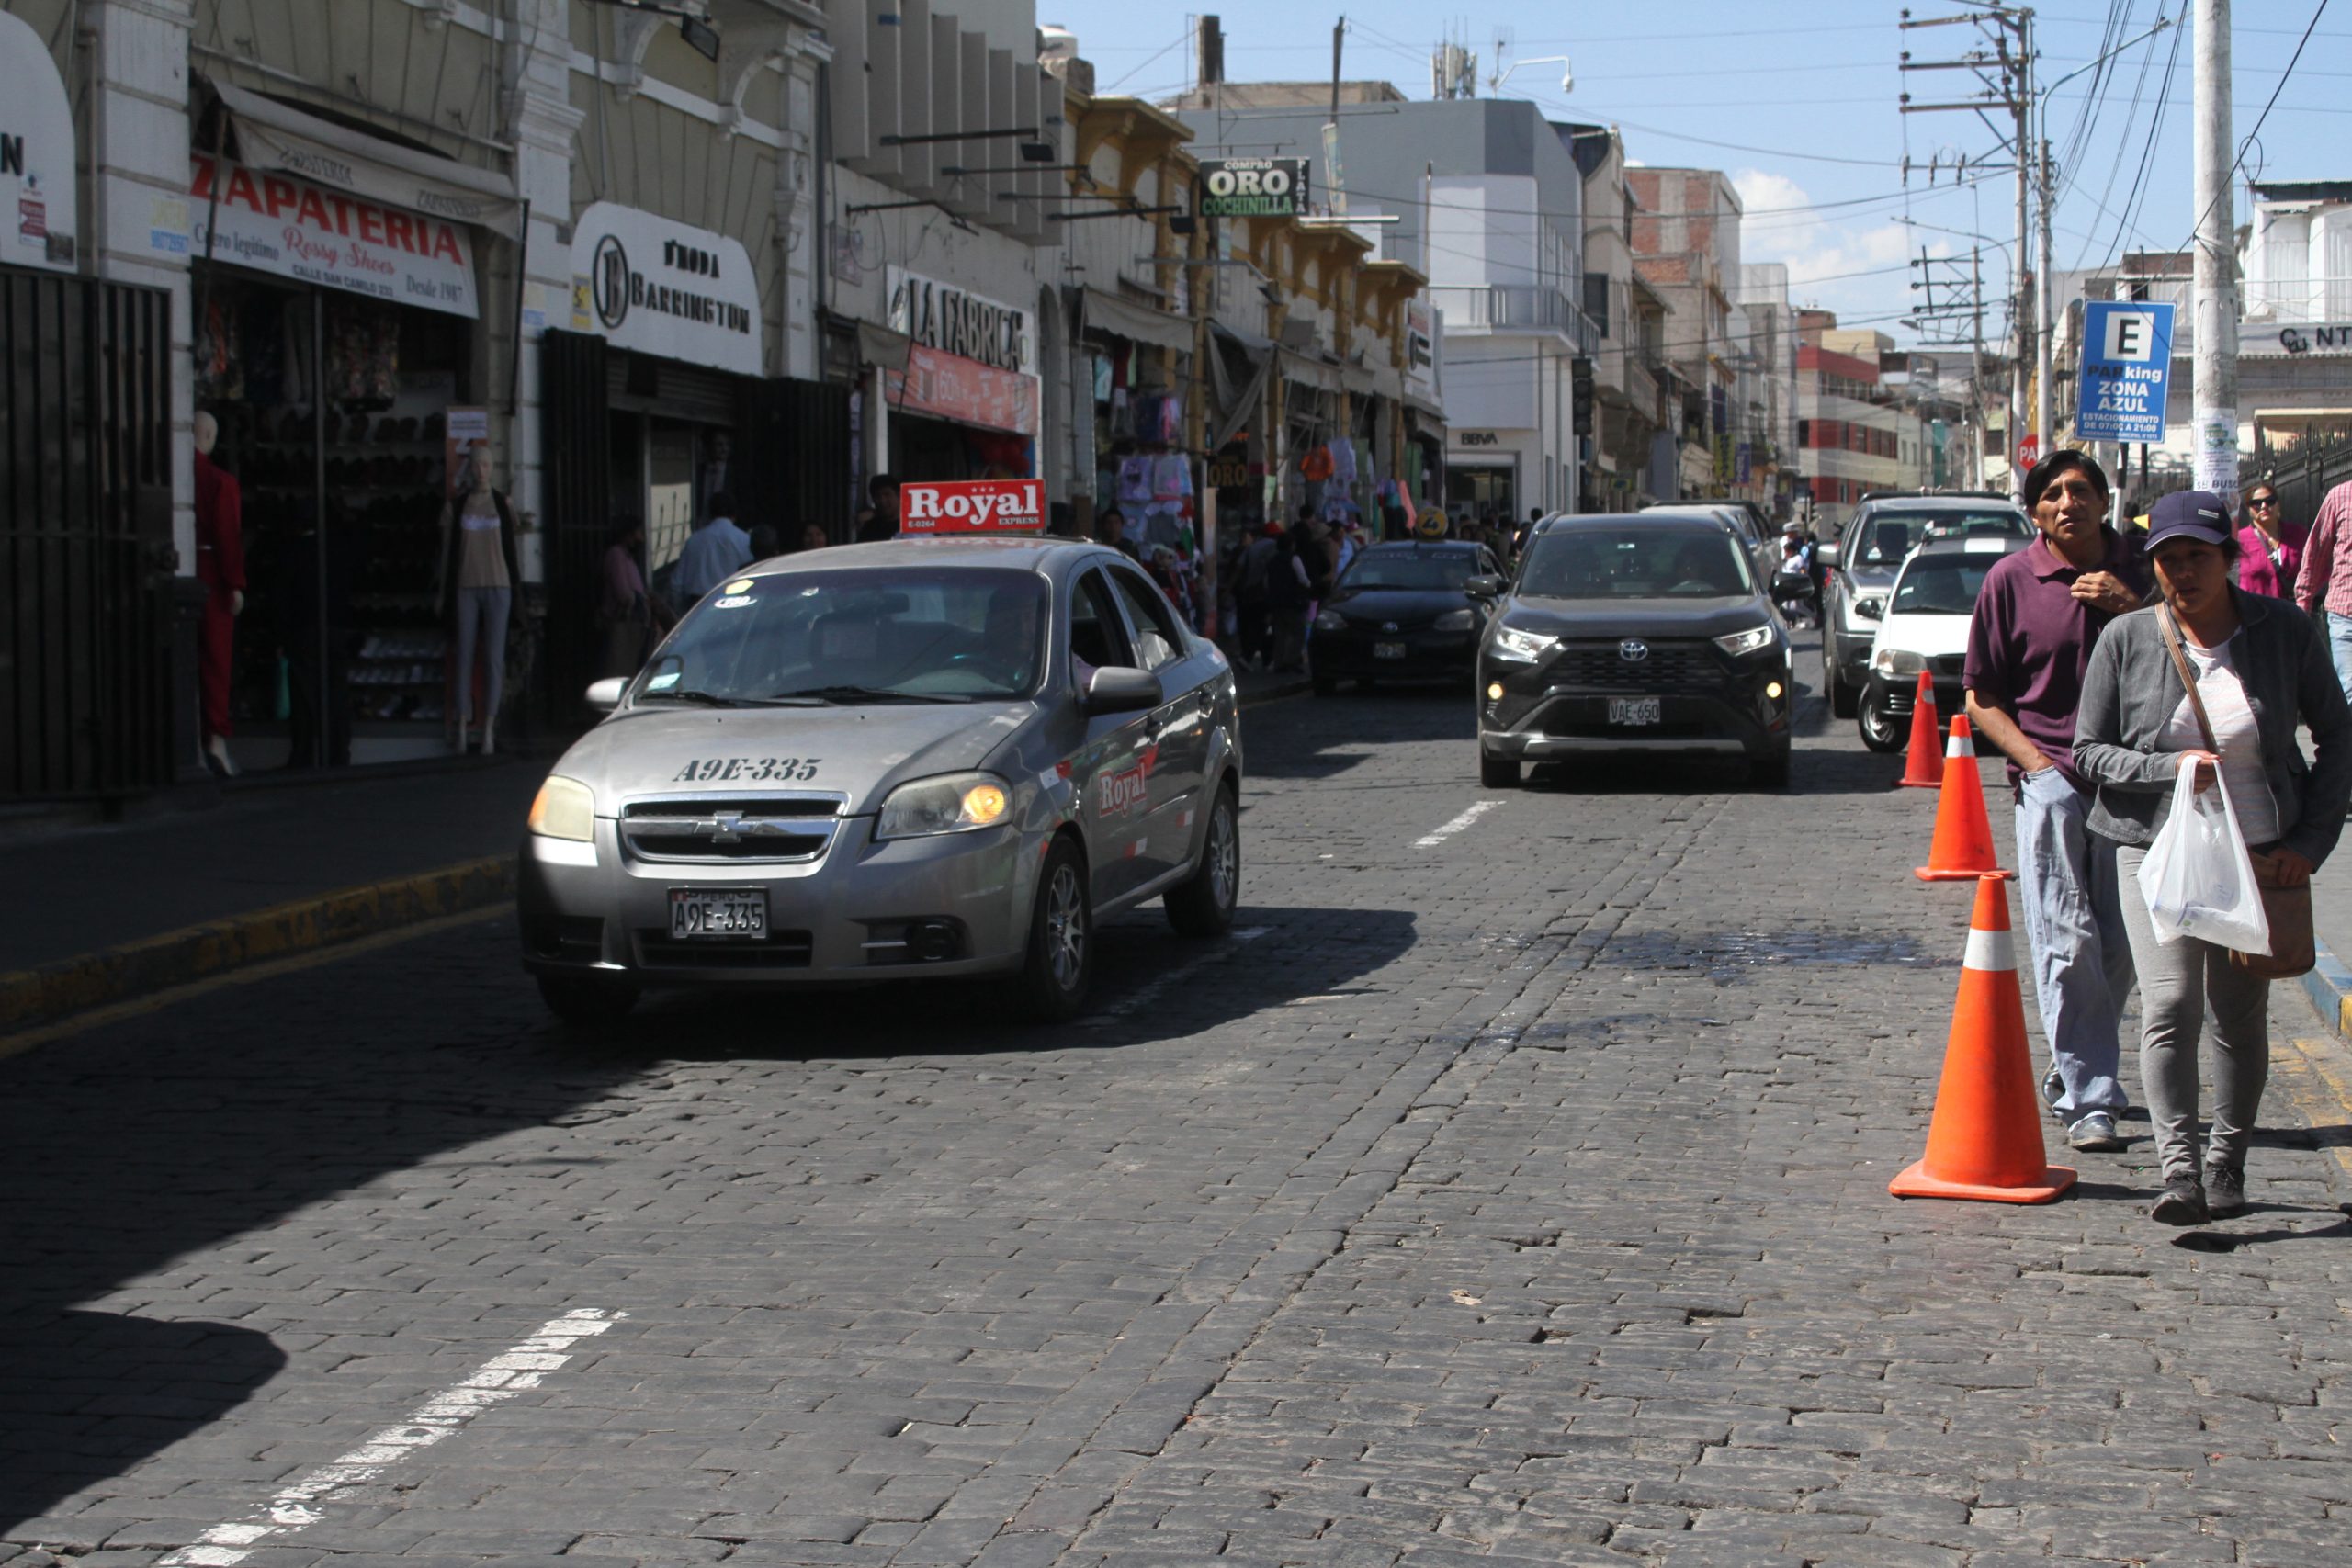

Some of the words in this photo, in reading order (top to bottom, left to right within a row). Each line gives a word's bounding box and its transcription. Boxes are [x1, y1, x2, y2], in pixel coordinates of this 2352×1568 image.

[1223, 160, 1273, 171] COMPRO
[1208, 169, 1290, 197] ORO
[1295, 159, 1306, 213] PLATA
[190, 154, 466, 267] ZAPATERIA
[1202, 196, 1294, 216] COCHINILLA
[292, 264, 322, 280] CALLE
[631, 271, 750, 334] BARRINGTON
[910, 279, 936, 349] LA
[941, 289, 1024, 374] FABRICA
[2117, 318, 2140, 355] E
[2086, 365, 2163, 383] PARking
[2098, 381, 2149, 397] ZONA
[2097, 396, 2148, 412] AZUL
[2082, 412, 2159, 424] ESTACIONAMIENTO
[2083, 422, 2097, 430] DE
[2125, 423, 2134, 432] A
[2134, 423, 2156, 433] 21:00
[1460, 433, 1498, 446] BBVA
[2019, 446, 2037, 462] PA
[907, 485, 1039, 525] Royal
[998, 516, 1040, 525] EXPRESS
[1611, 704, 1659, 720] VAE-650
[672, 758, 823, 782] A9E-335
[1100, 761, 1146, 811] Royal
[673, 902, 763, 931] A9E-335
